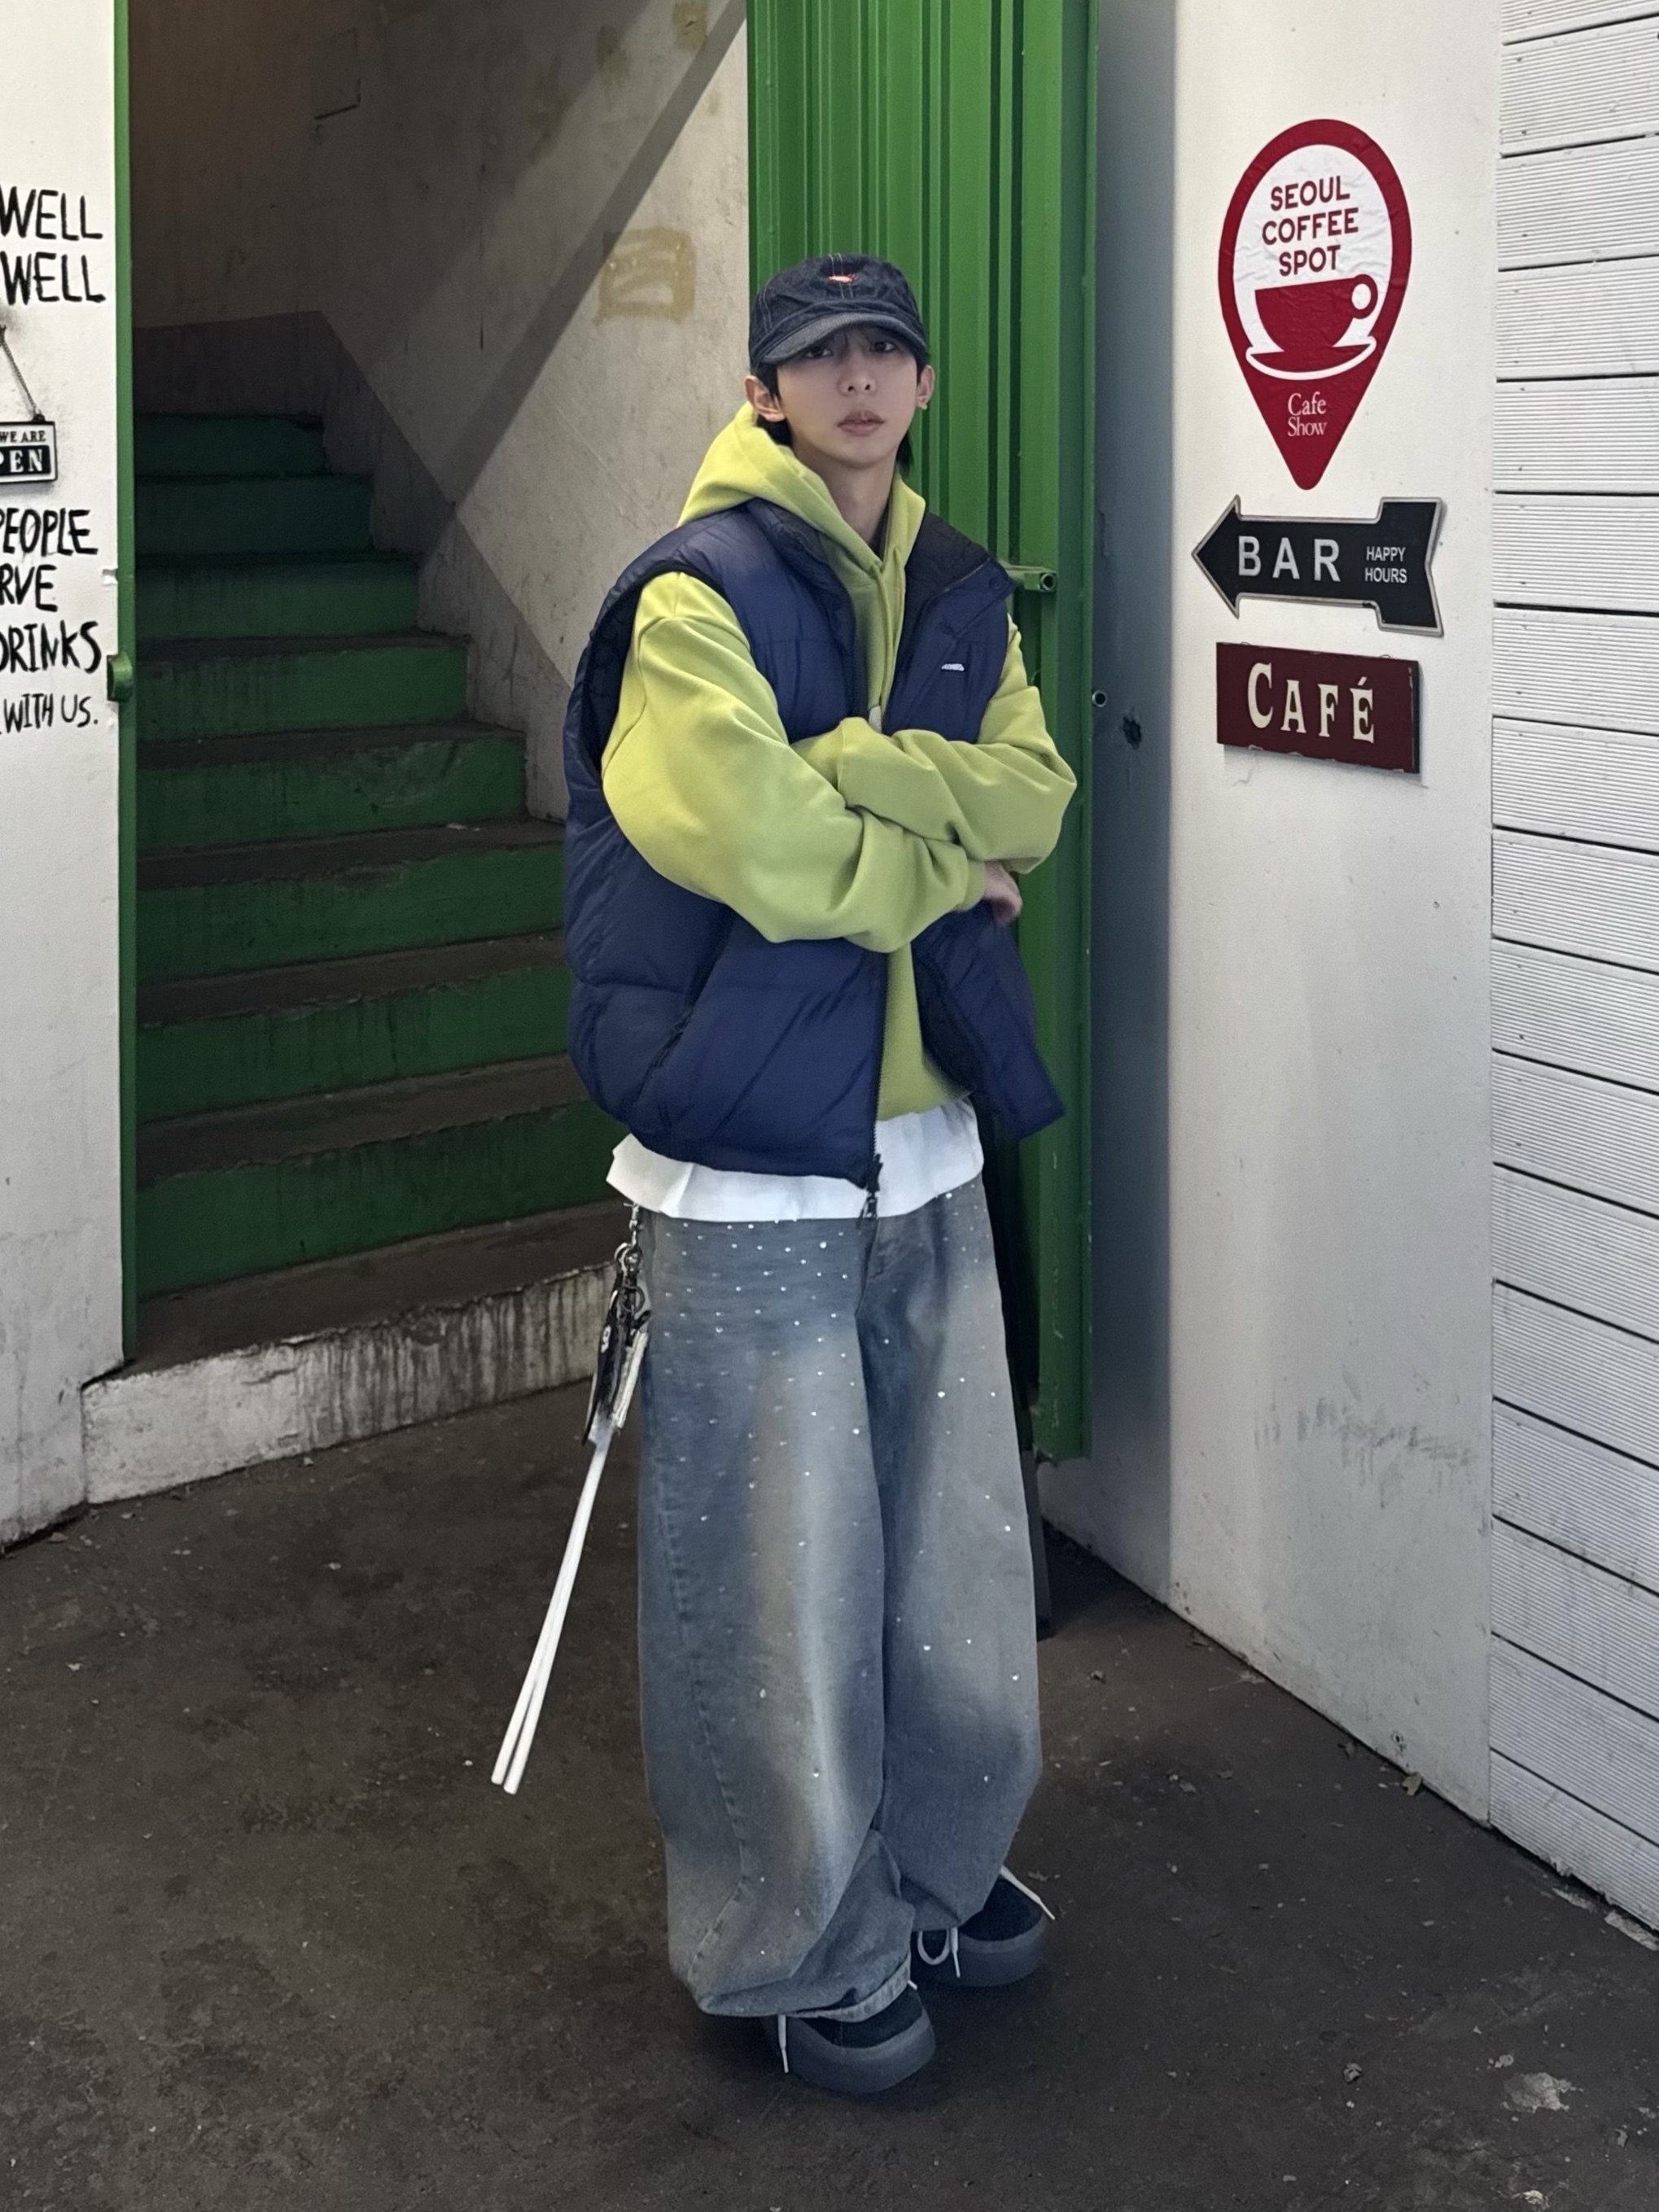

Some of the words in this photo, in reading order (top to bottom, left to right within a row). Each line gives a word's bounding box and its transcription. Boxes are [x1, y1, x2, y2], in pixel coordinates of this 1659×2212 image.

[1271, 175, 1350, 212] SEOUL
[0, 184, 103, 241] WELL
[1263, 207, 1359, 246] COFFEE
[0, 251, 107, 306] WELL
[1279, 244, 1341, 277] SPOT
[1288, 391, 1327, 416] Cafe
[0, 431, 17, 443] WE
[20, 430, 46, 443] ARE
[1288, 416, 1327, 437] Show
[1238, 536, 1341, 583] BAR
[1366, 546, 1406, 562] HAPPY
[1364, 567, 1407, 584] HOURS
[4, 693, 54, 733] WITH
[61, 694, 98, 728] US.
[1247, 662, 1375, 744] CAFÉ
